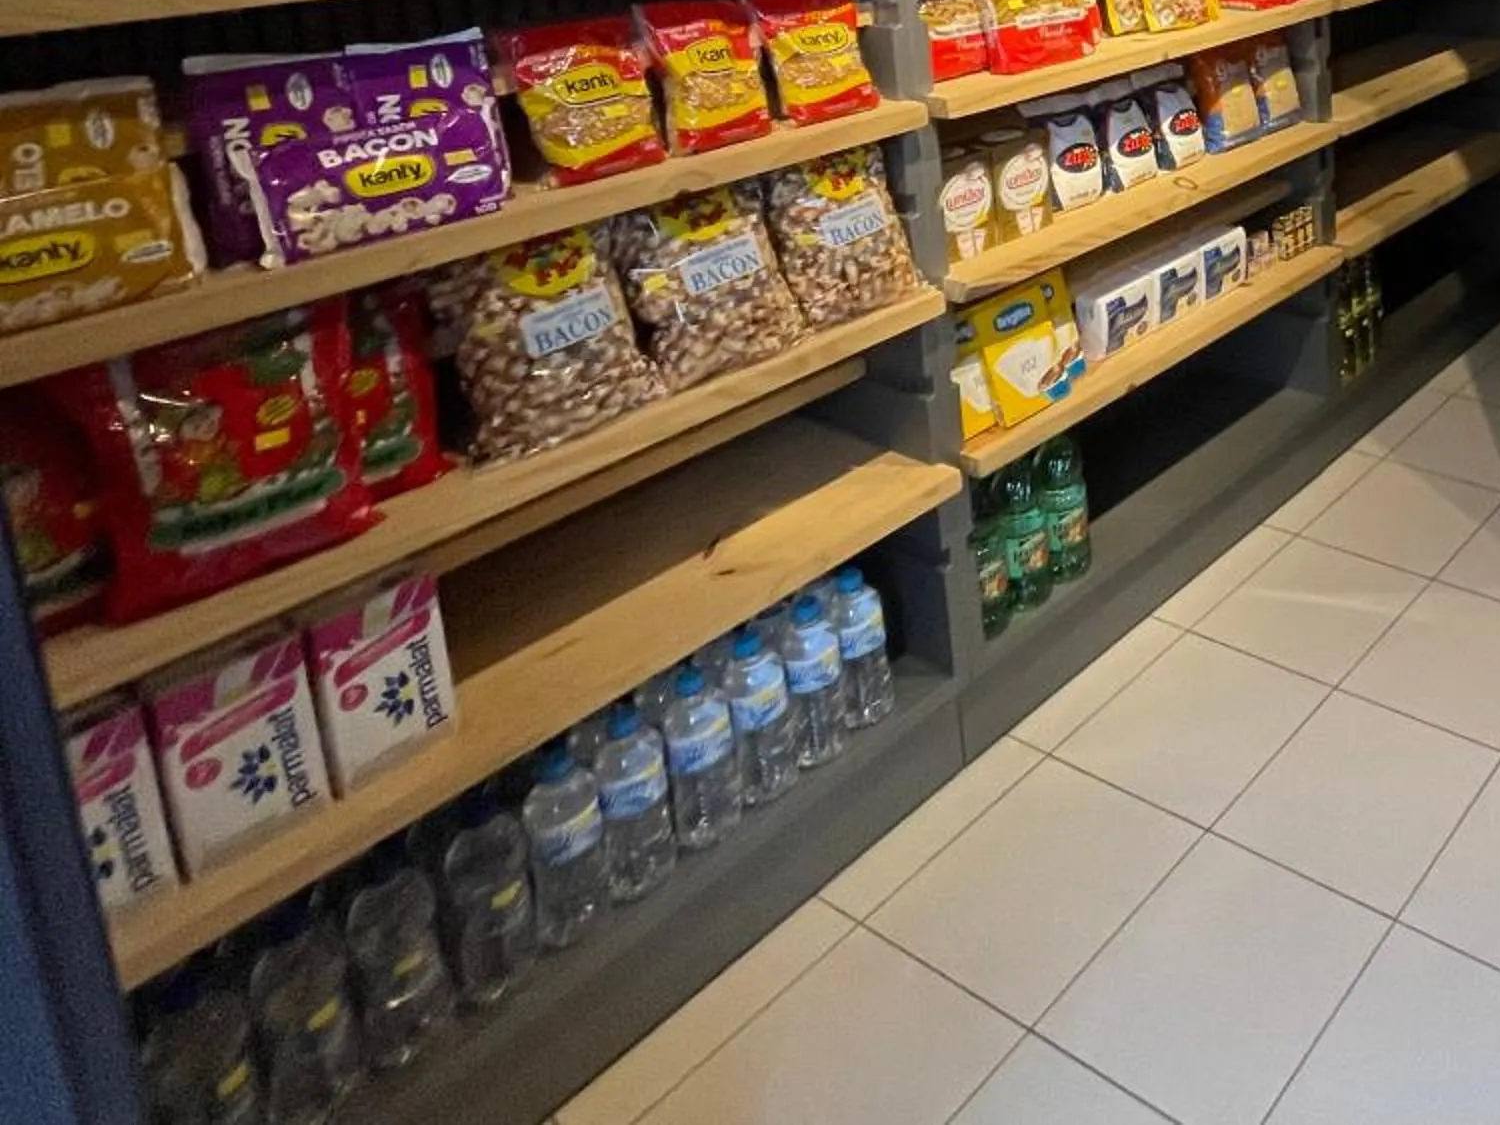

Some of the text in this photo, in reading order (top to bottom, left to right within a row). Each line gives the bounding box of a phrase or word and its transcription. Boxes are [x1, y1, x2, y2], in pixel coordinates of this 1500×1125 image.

[696, 43, 731, 63] kan
[316, 128, 439, 169] BACON
[358, 162, 425, 189] kanty
[0, 197, 132, 238] AMELO
[688, 250, 764, 294] BACON
[534, 305, 614, 354] BACON
[404, 634, 450, 733] parmalat
[266, 706, 319, 810] parmalat
